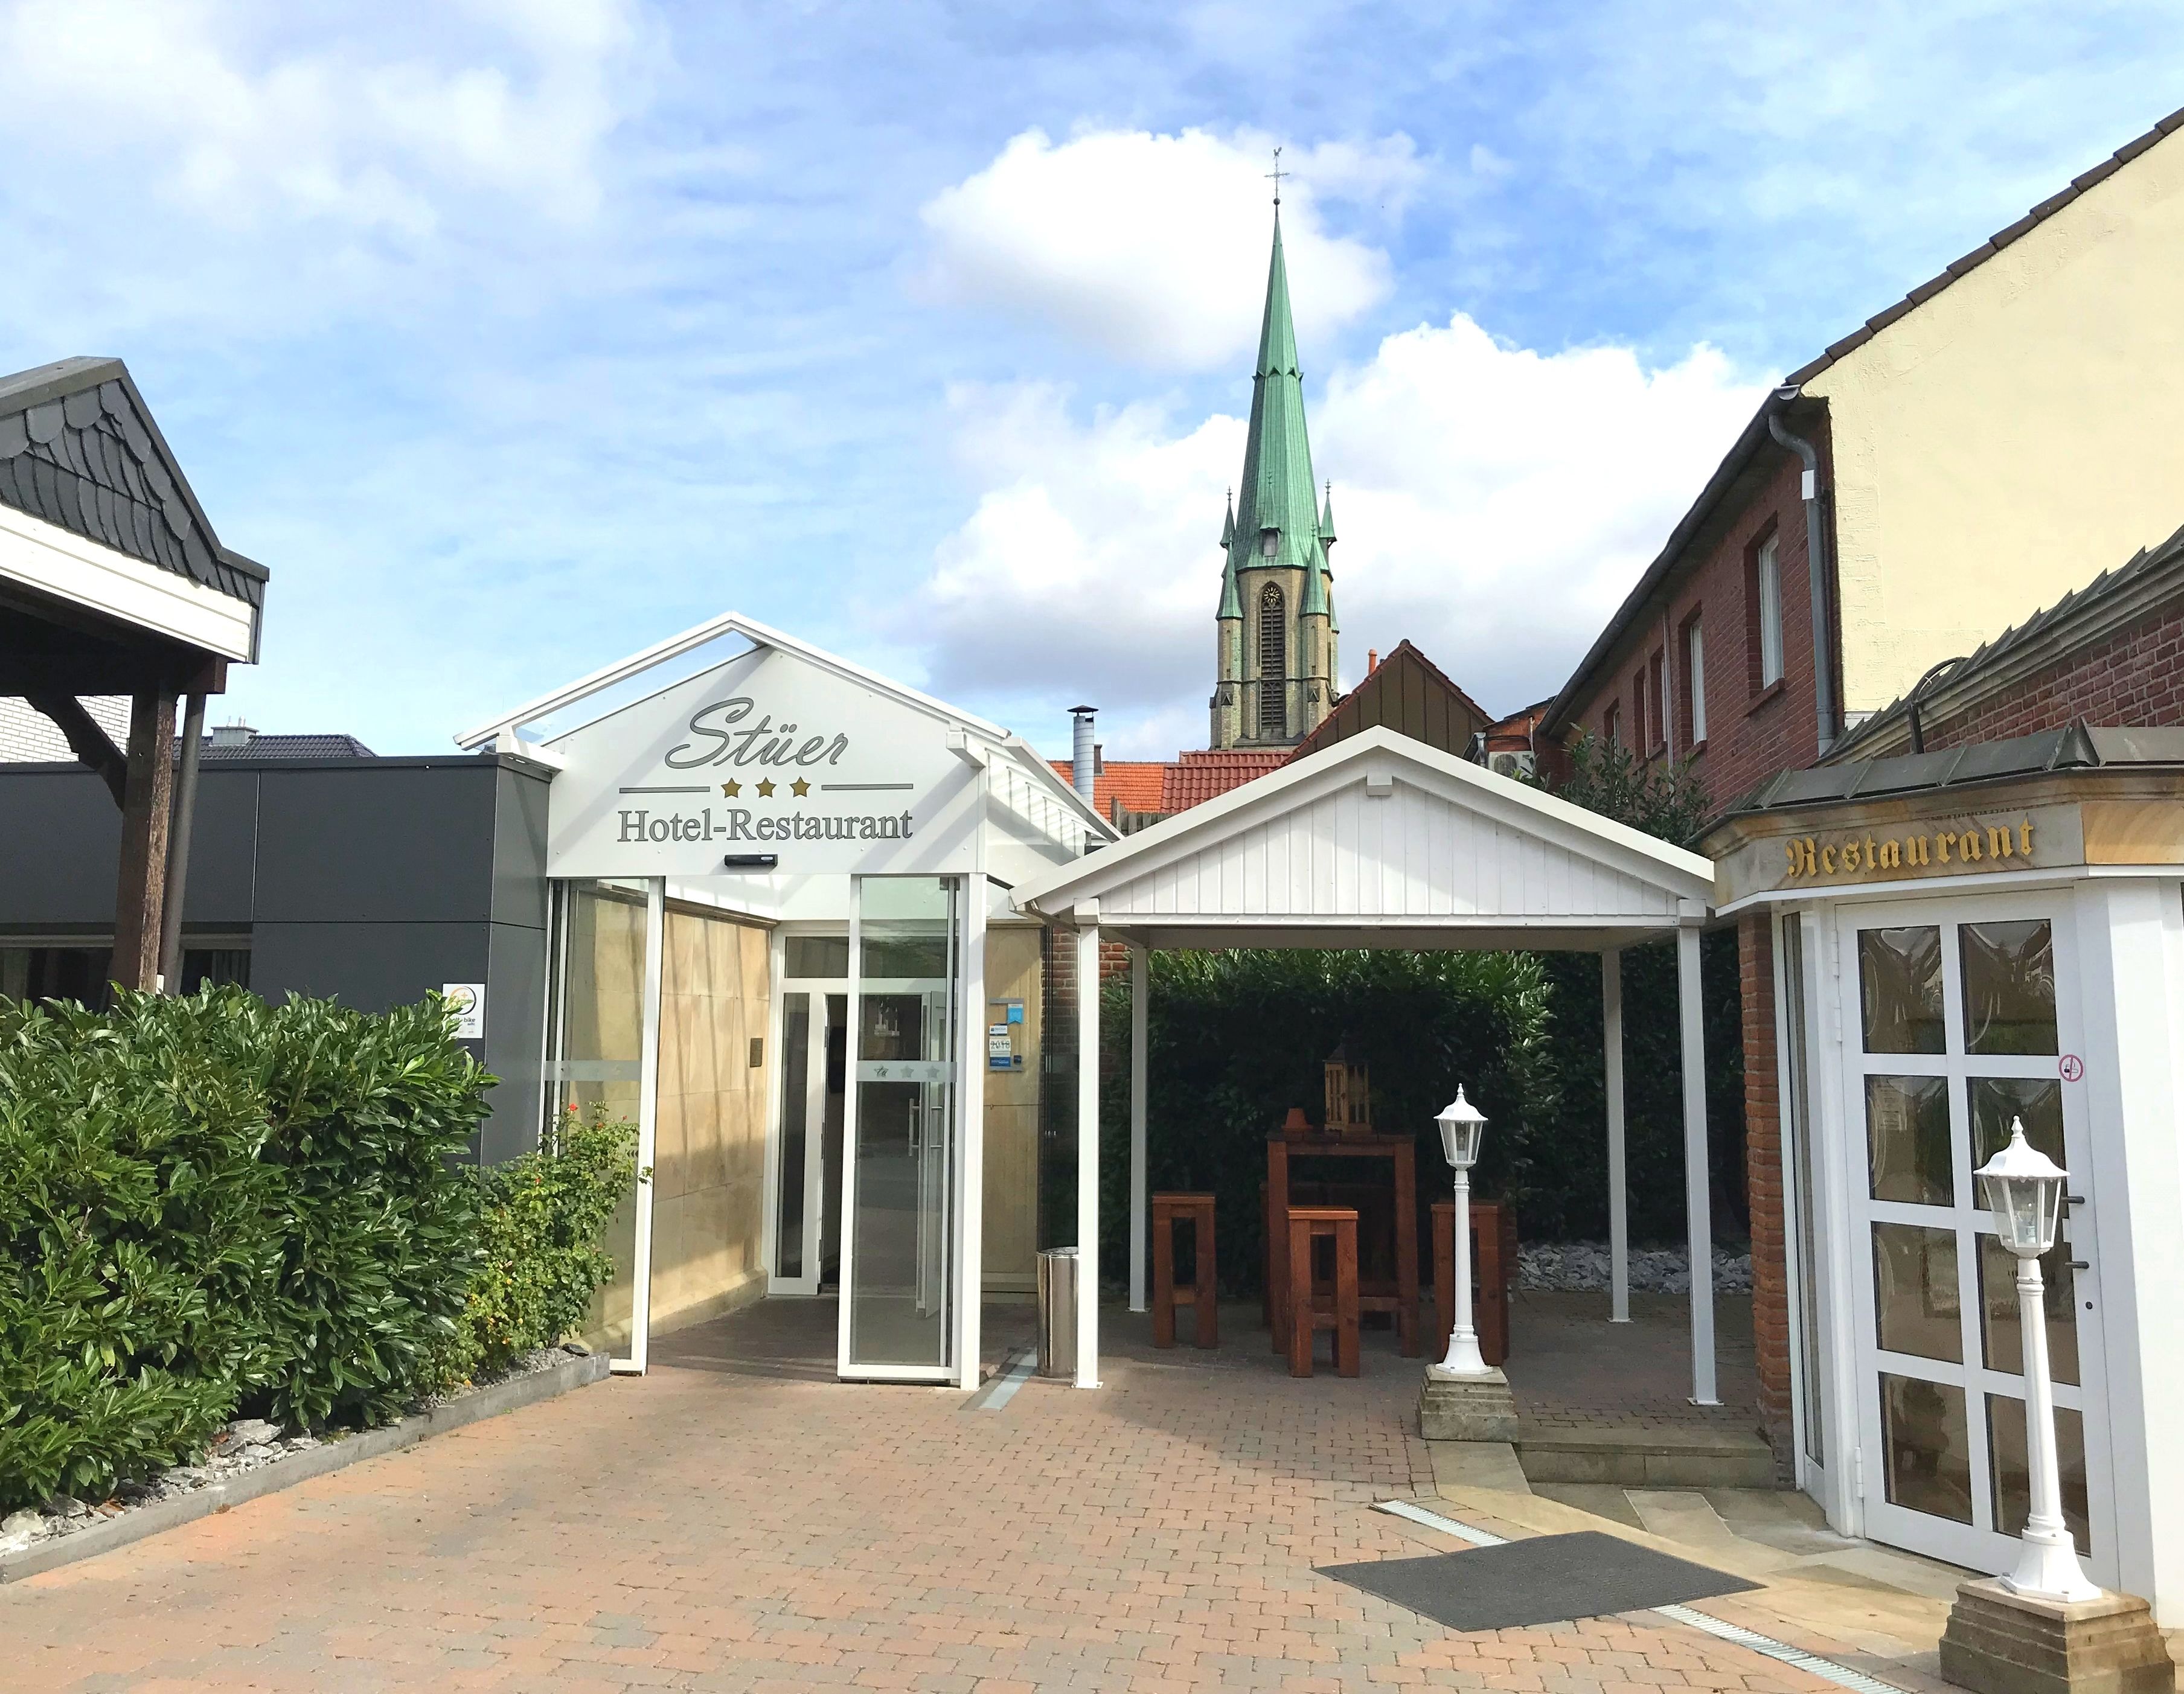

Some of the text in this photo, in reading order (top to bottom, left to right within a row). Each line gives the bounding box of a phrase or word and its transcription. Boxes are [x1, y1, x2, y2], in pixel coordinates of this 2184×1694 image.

[664, 697, 848, 769] Stüer
[618, 808, 912, 842] Hotel-Restaurant
[1786, 813, 2034, 877] Restaurant
